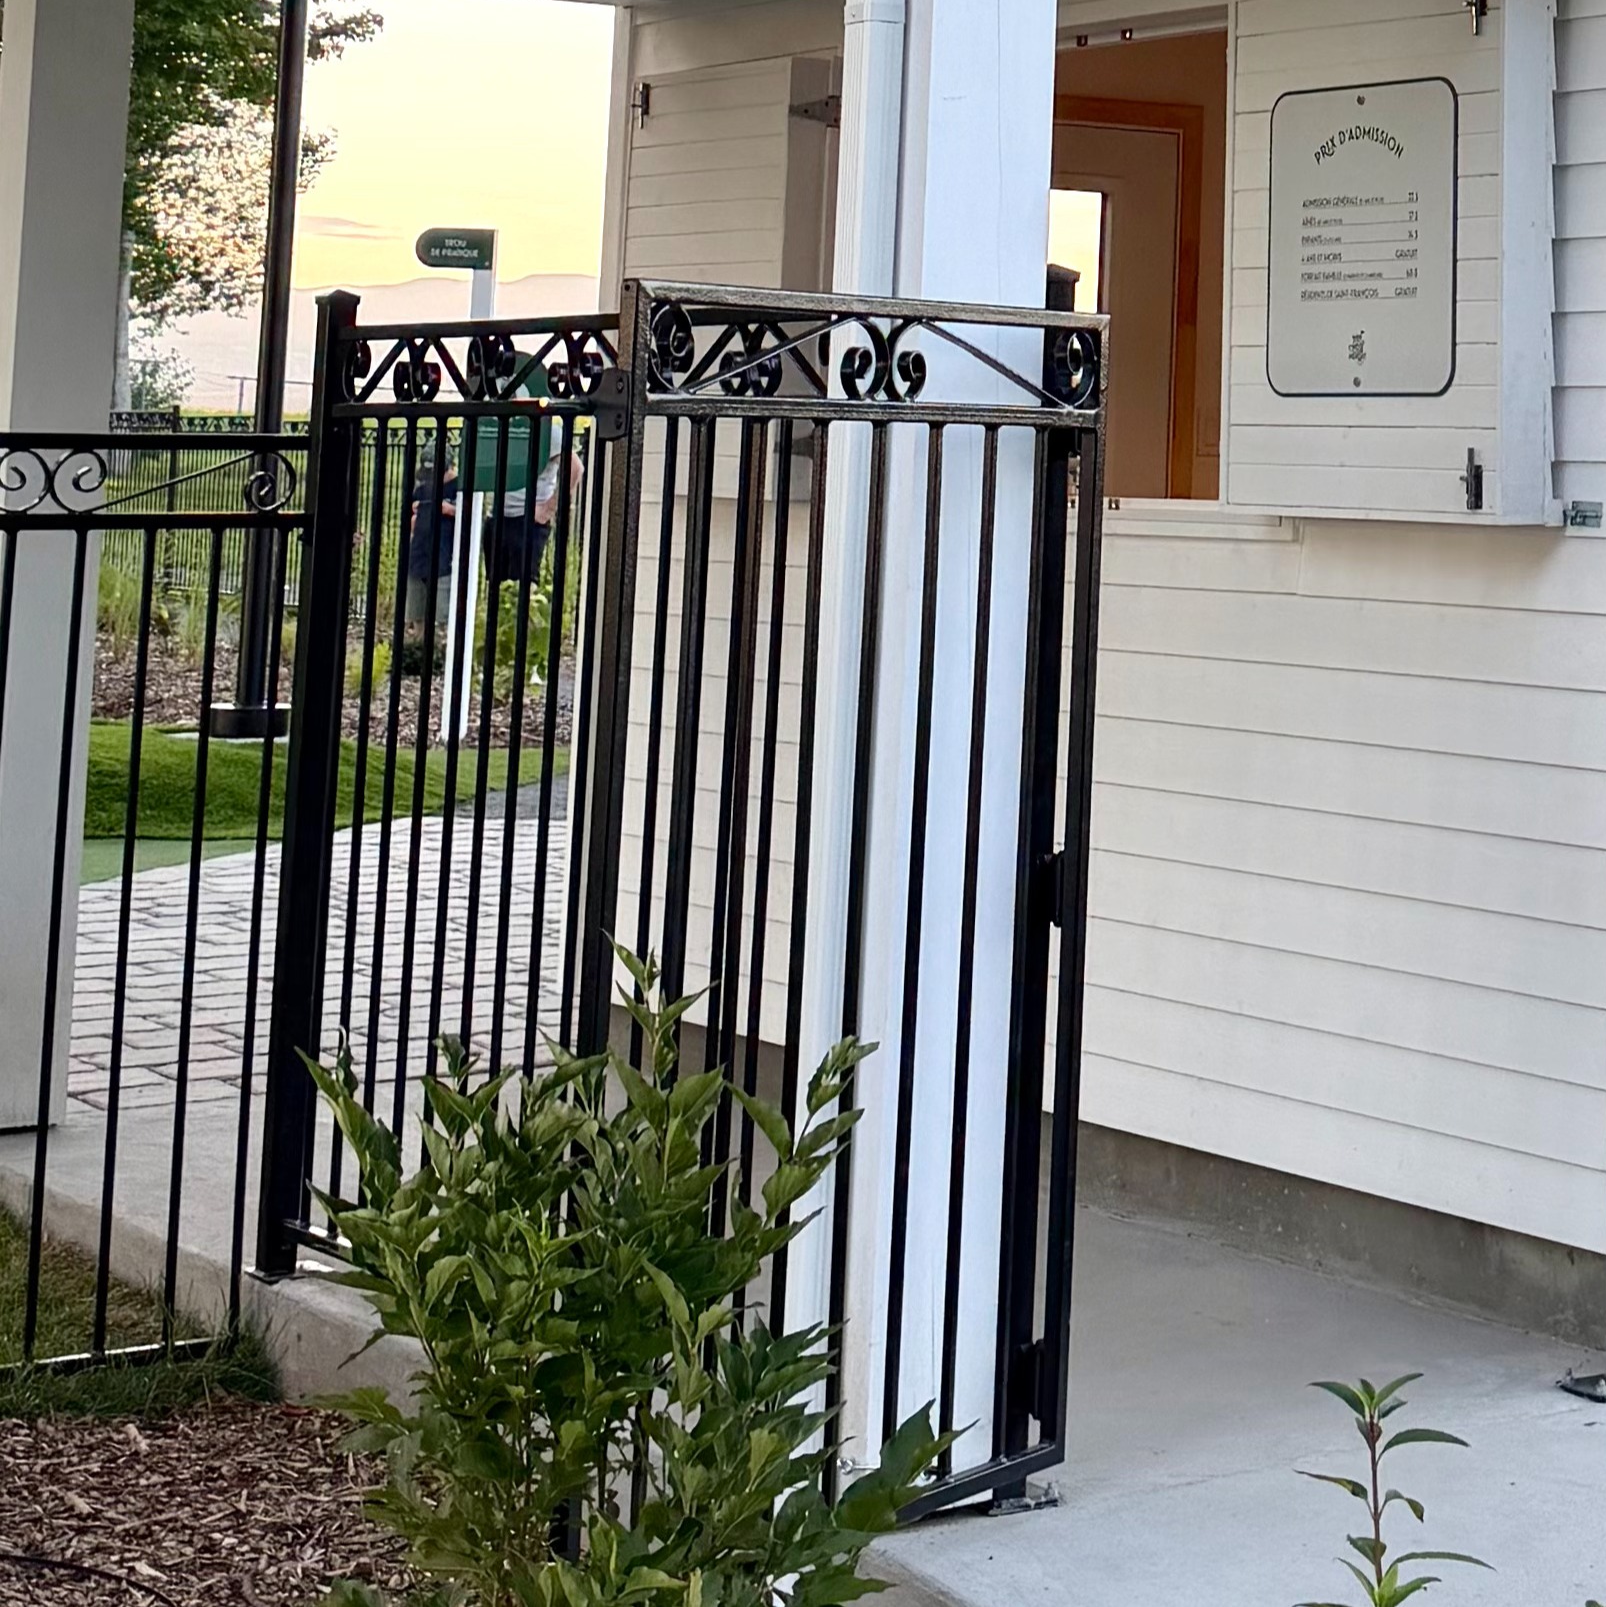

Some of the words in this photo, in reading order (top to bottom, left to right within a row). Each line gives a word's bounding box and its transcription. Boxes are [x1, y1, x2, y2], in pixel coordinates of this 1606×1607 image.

[1314, 135, 1337, 165] PRIX
[1338, 125, 1404, 159] D'ADMISSION
[444, 239, 467, 248] TROU
